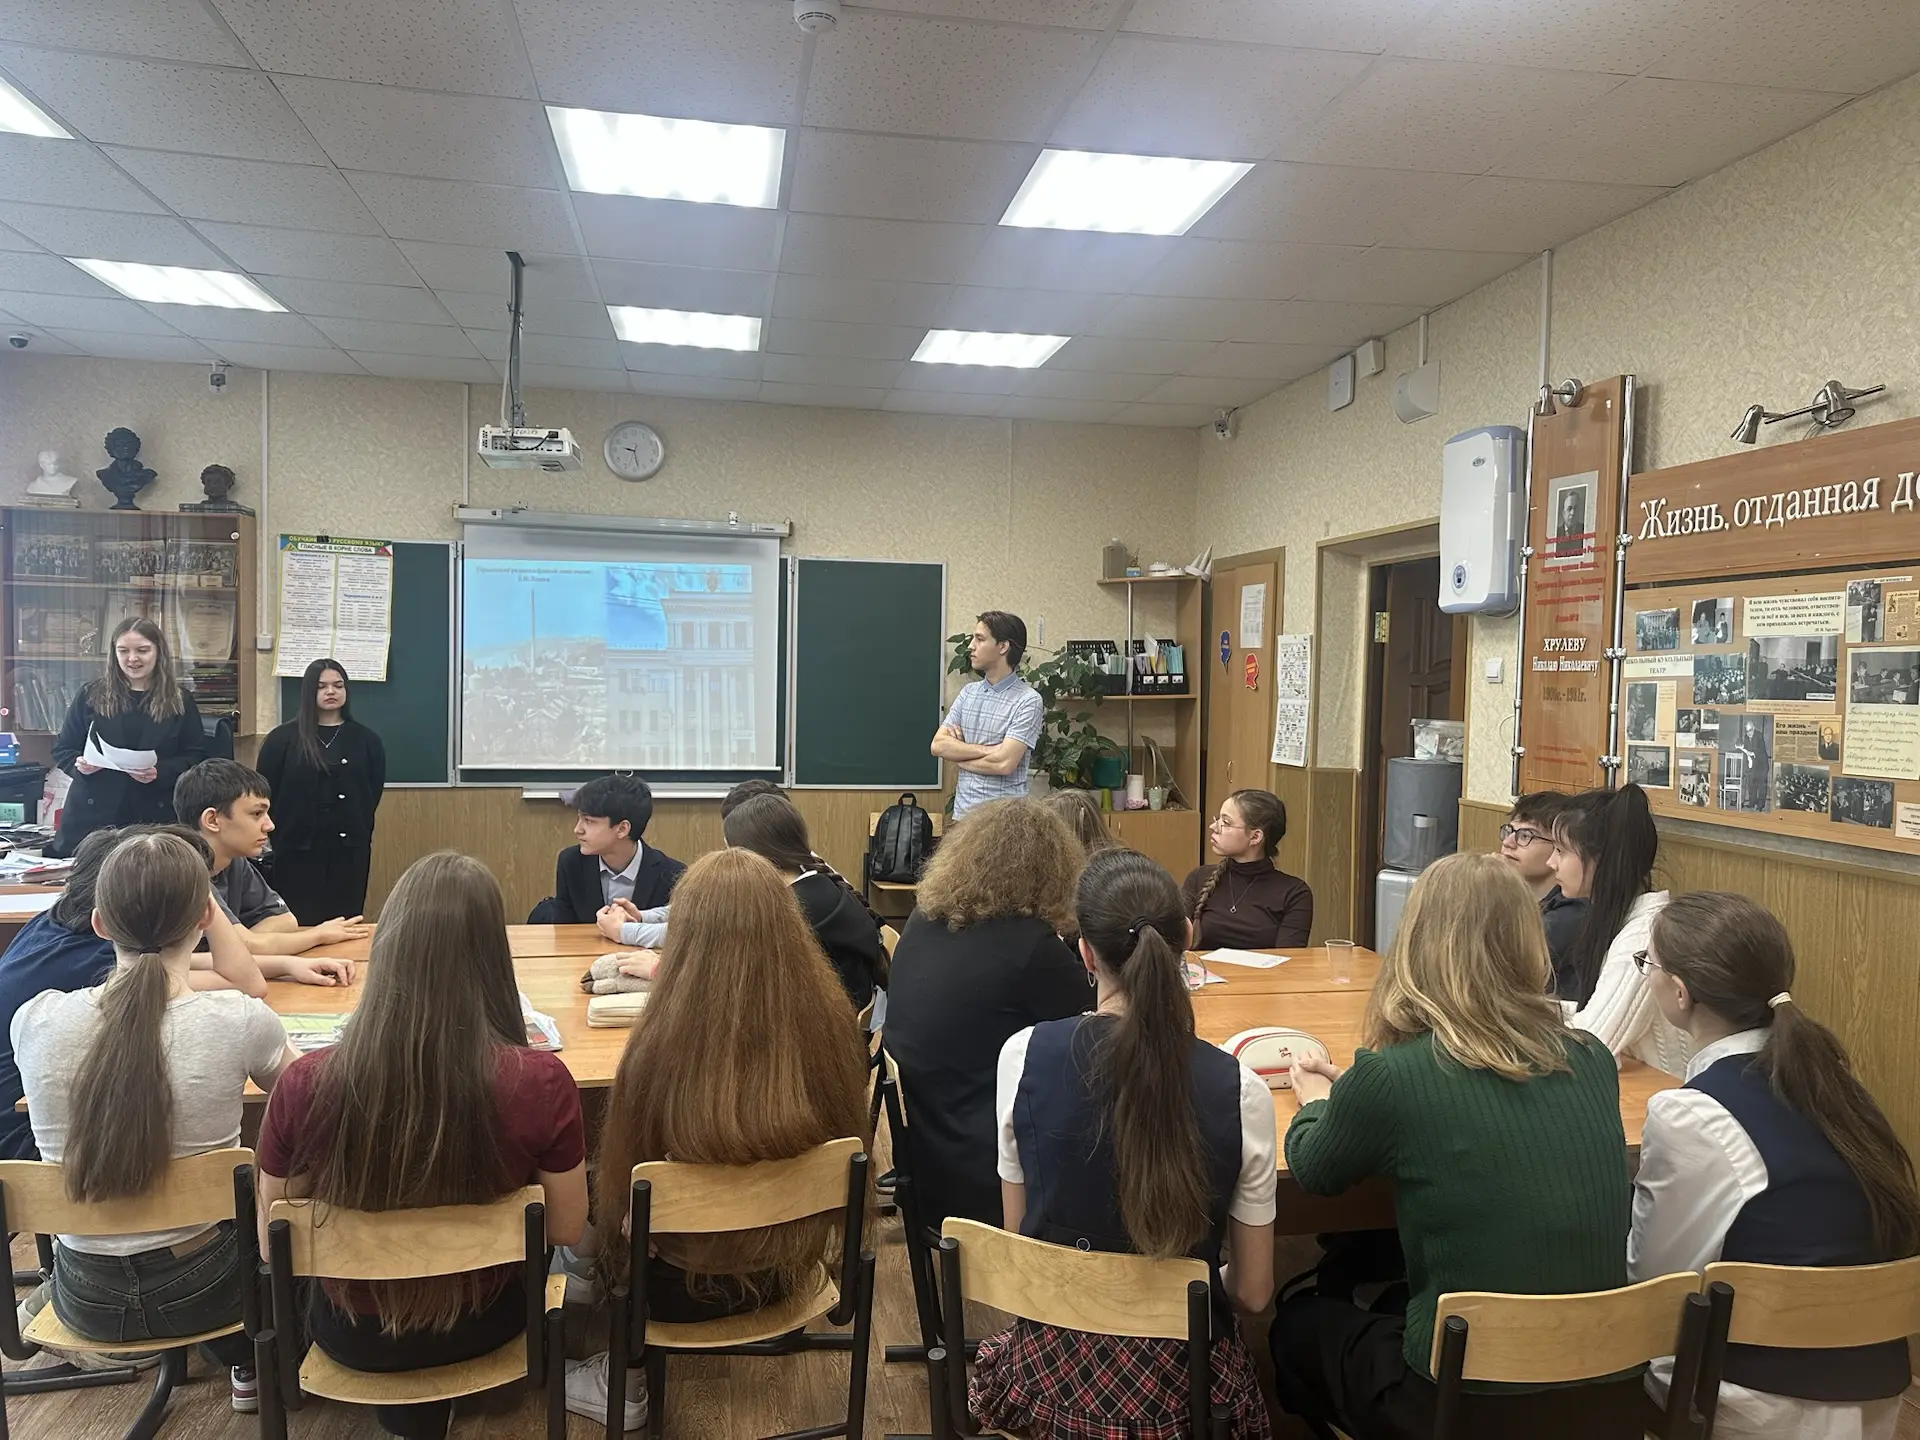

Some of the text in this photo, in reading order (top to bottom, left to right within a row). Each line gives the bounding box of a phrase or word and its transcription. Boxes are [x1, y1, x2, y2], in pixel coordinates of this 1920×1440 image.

[1638, 497, 1730, 540] Жизнь,
[1733, 477, 1880, 530] отданная
[1543, 638, 1587, 652] ХРУЛЕВУ
[1532, 656, 1599, 678] Николаю Николаевичу
